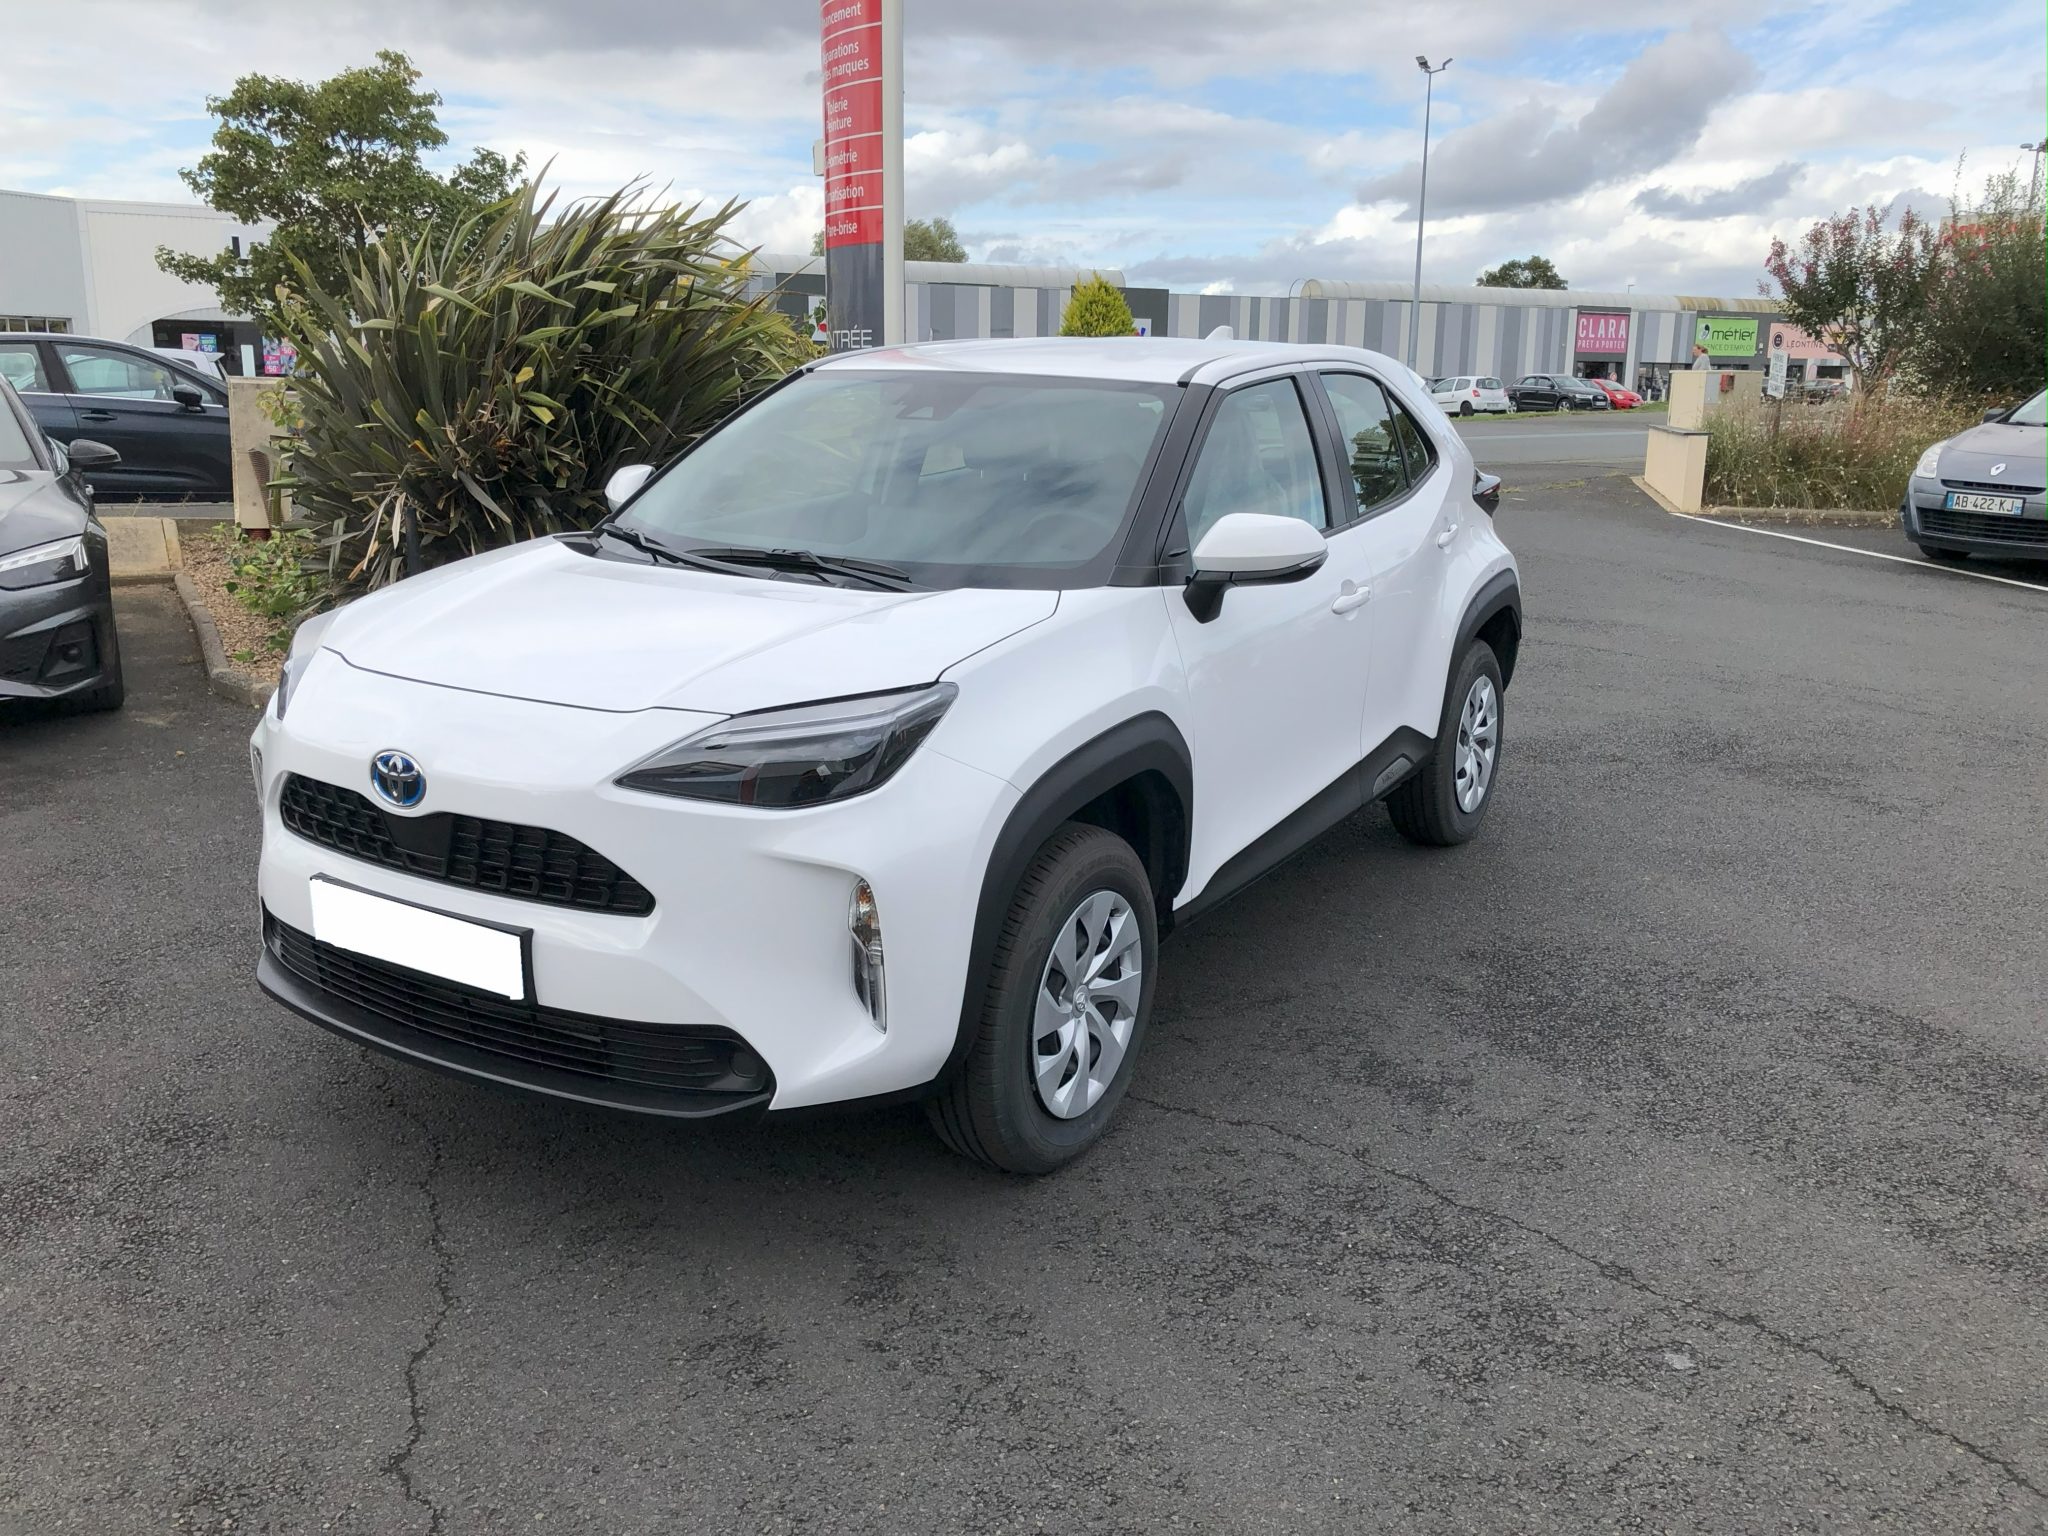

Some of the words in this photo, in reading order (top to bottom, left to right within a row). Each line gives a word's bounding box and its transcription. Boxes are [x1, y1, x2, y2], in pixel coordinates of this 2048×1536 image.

[832, 58, 869, 76] marques
[827, 324, 872, 348] NTRÉE
[1578, 318, 1626, 339] CLARA
[1711, 327, 1755, 341] métier
[1954, 495, 2015, 512] AB-422-KJ
